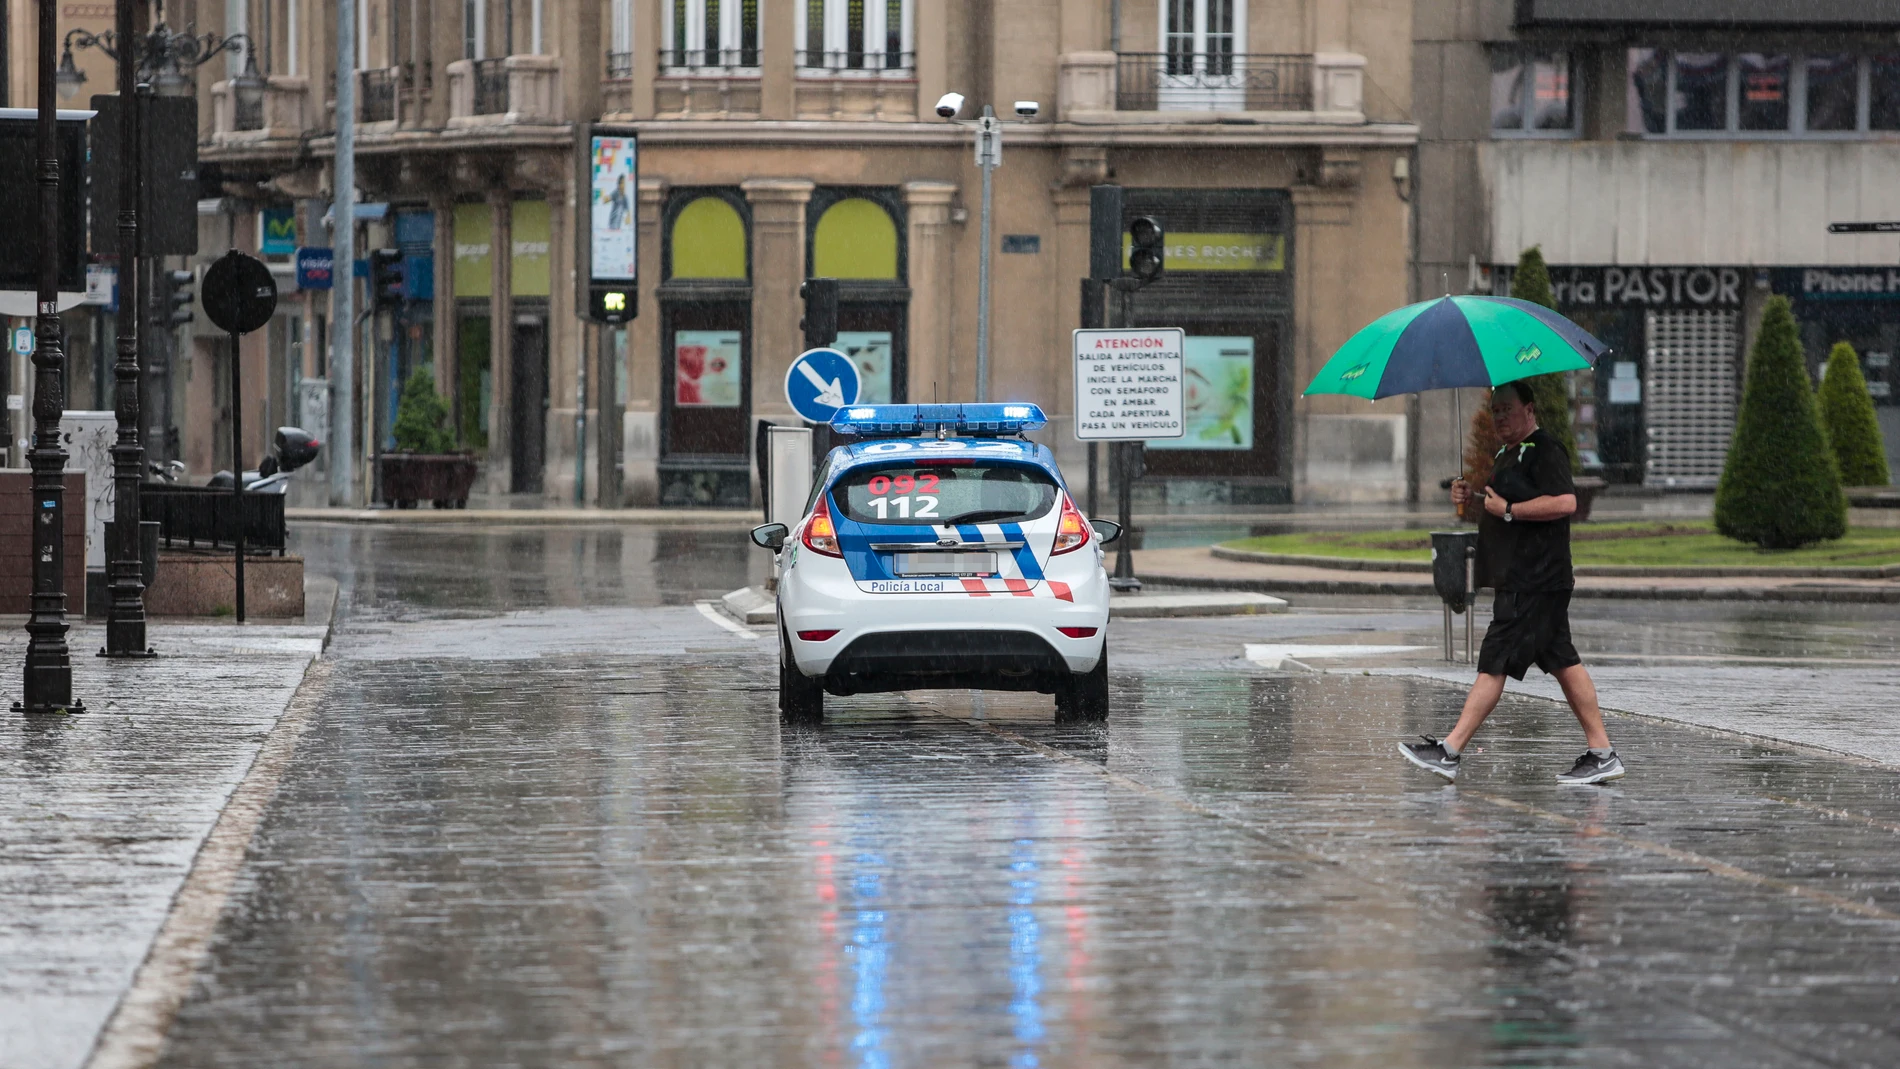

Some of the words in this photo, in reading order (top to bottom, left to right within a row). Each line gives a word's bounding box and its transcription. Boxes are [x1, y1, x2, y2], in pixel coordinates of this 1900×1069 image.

[1604, 268, 1740, 303] PASTOR
[1803, 269, 1884, 292] Phone
[1095, 336, 1164, 349] ATENCIÓN
[1079, 353, 1112, 361] SALIDA
[1093, 364, 1106, 372] DE
[1138, 375, 1178, 383] MARCHA
[1090, 387, 1111, 395] CON
[1089, 410, 1115, 418] CADA
[1120, 409, 1170, 418] APERTURA
[1082, 422, 1106, 430] PASA
[1112, 421, 1126, 429] UN
[867, 474, 940, 495] 092
[867, 496, 940, 519] 112
[871, 581, 910, 592] Policía
[914, 581, 944, 592] Local
